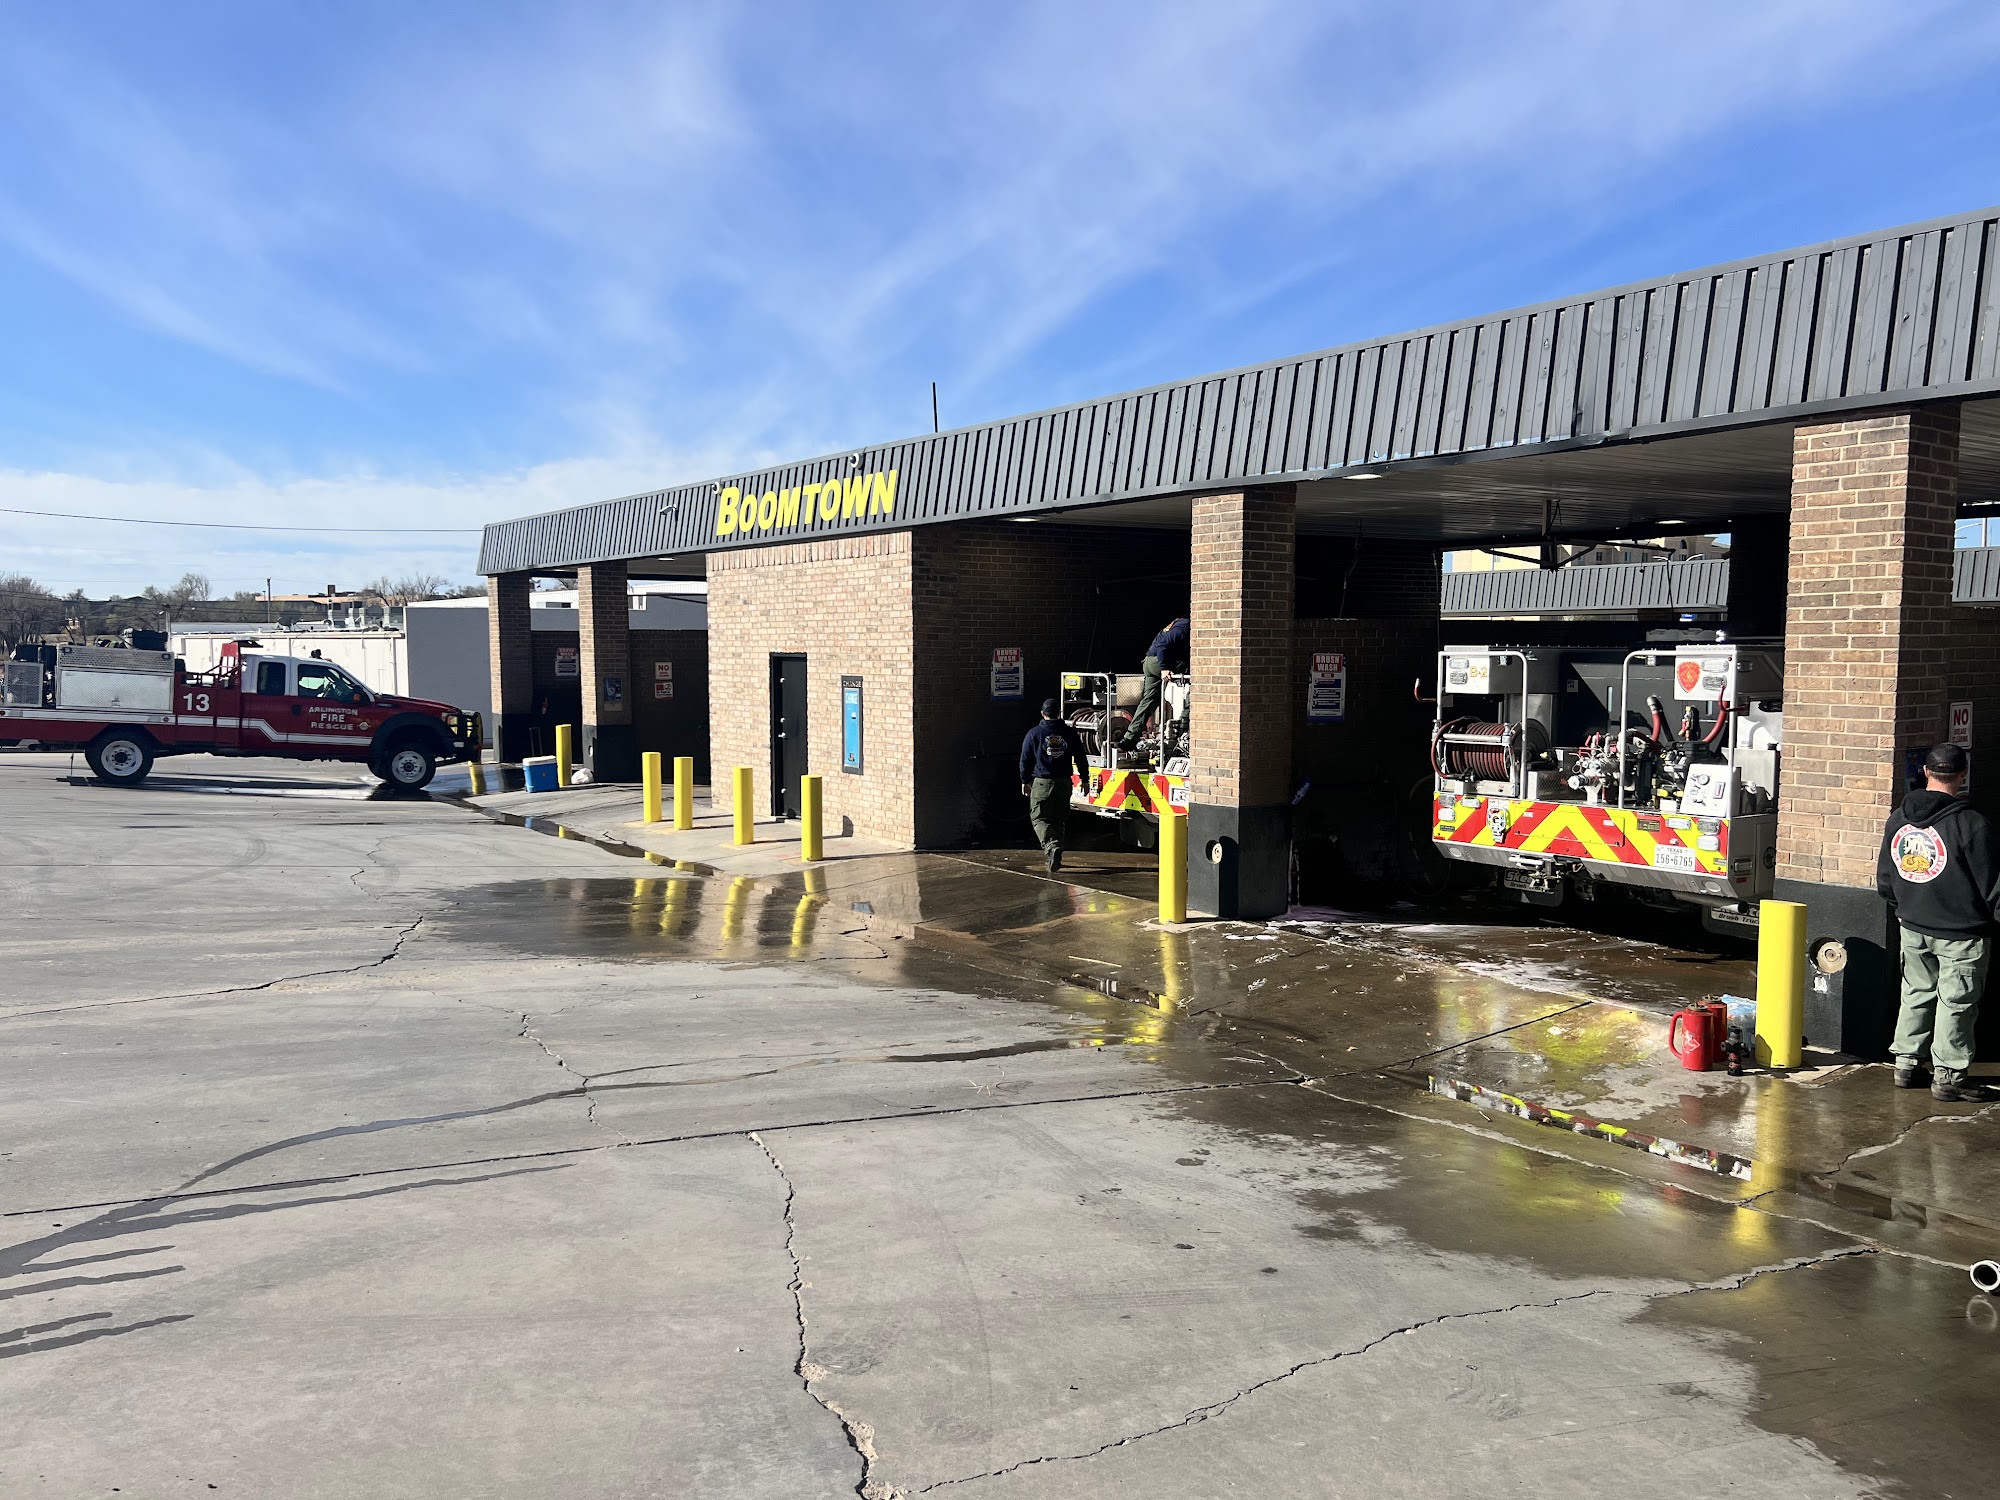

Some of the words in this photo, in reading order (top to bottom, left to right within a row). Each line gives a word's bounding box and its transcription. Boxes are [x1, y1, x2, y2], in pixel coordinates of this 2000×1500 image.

[716, 469, 898, 536] BOOMTOWN
[1316, 655, 1340, 664] BRUSH
[1317, 663, 1338, 672] WASH
[843, 680, 862, 688] CHANGE
[182, 692, 210, 712] 13
[309, 706, 358, 716] ARLINGTON
[320, 713, 346, 722] FIRE
[1953, 708, 1969, 726] NO
[310, 722, 354, 730] RESCUE
